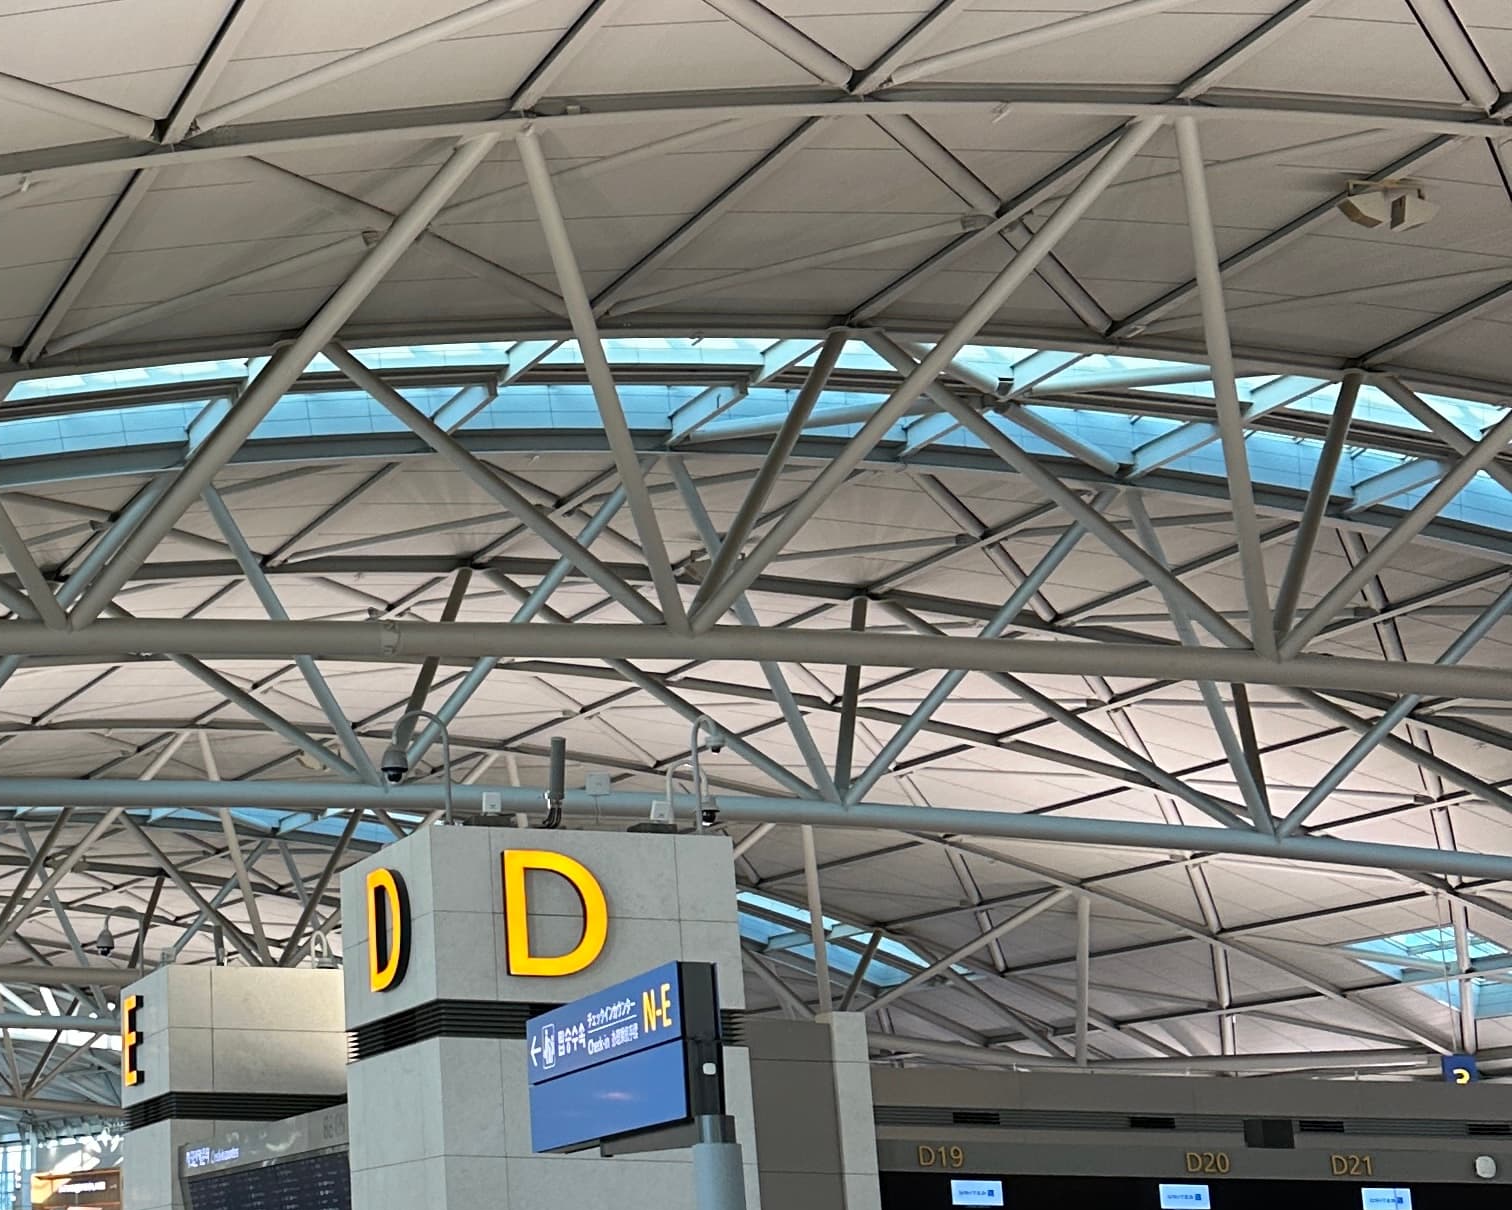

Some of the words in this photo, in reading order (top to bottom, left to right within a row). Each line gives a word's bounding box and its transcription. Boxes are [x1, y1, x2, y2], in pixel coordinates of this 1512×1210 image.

[366, 867, 411, 993] D
[502, 849, 608, 976] D
[642, 983, 672, 1033] N-E
[123, 993, 144, 1087] E
[557, 1022, 587, 1057] 탑승수속
[917, 1145, 964, 1168] D19
[1186, 1152, 1230, 1173] D20
[1331, 1155, 1373, 1176] D21
